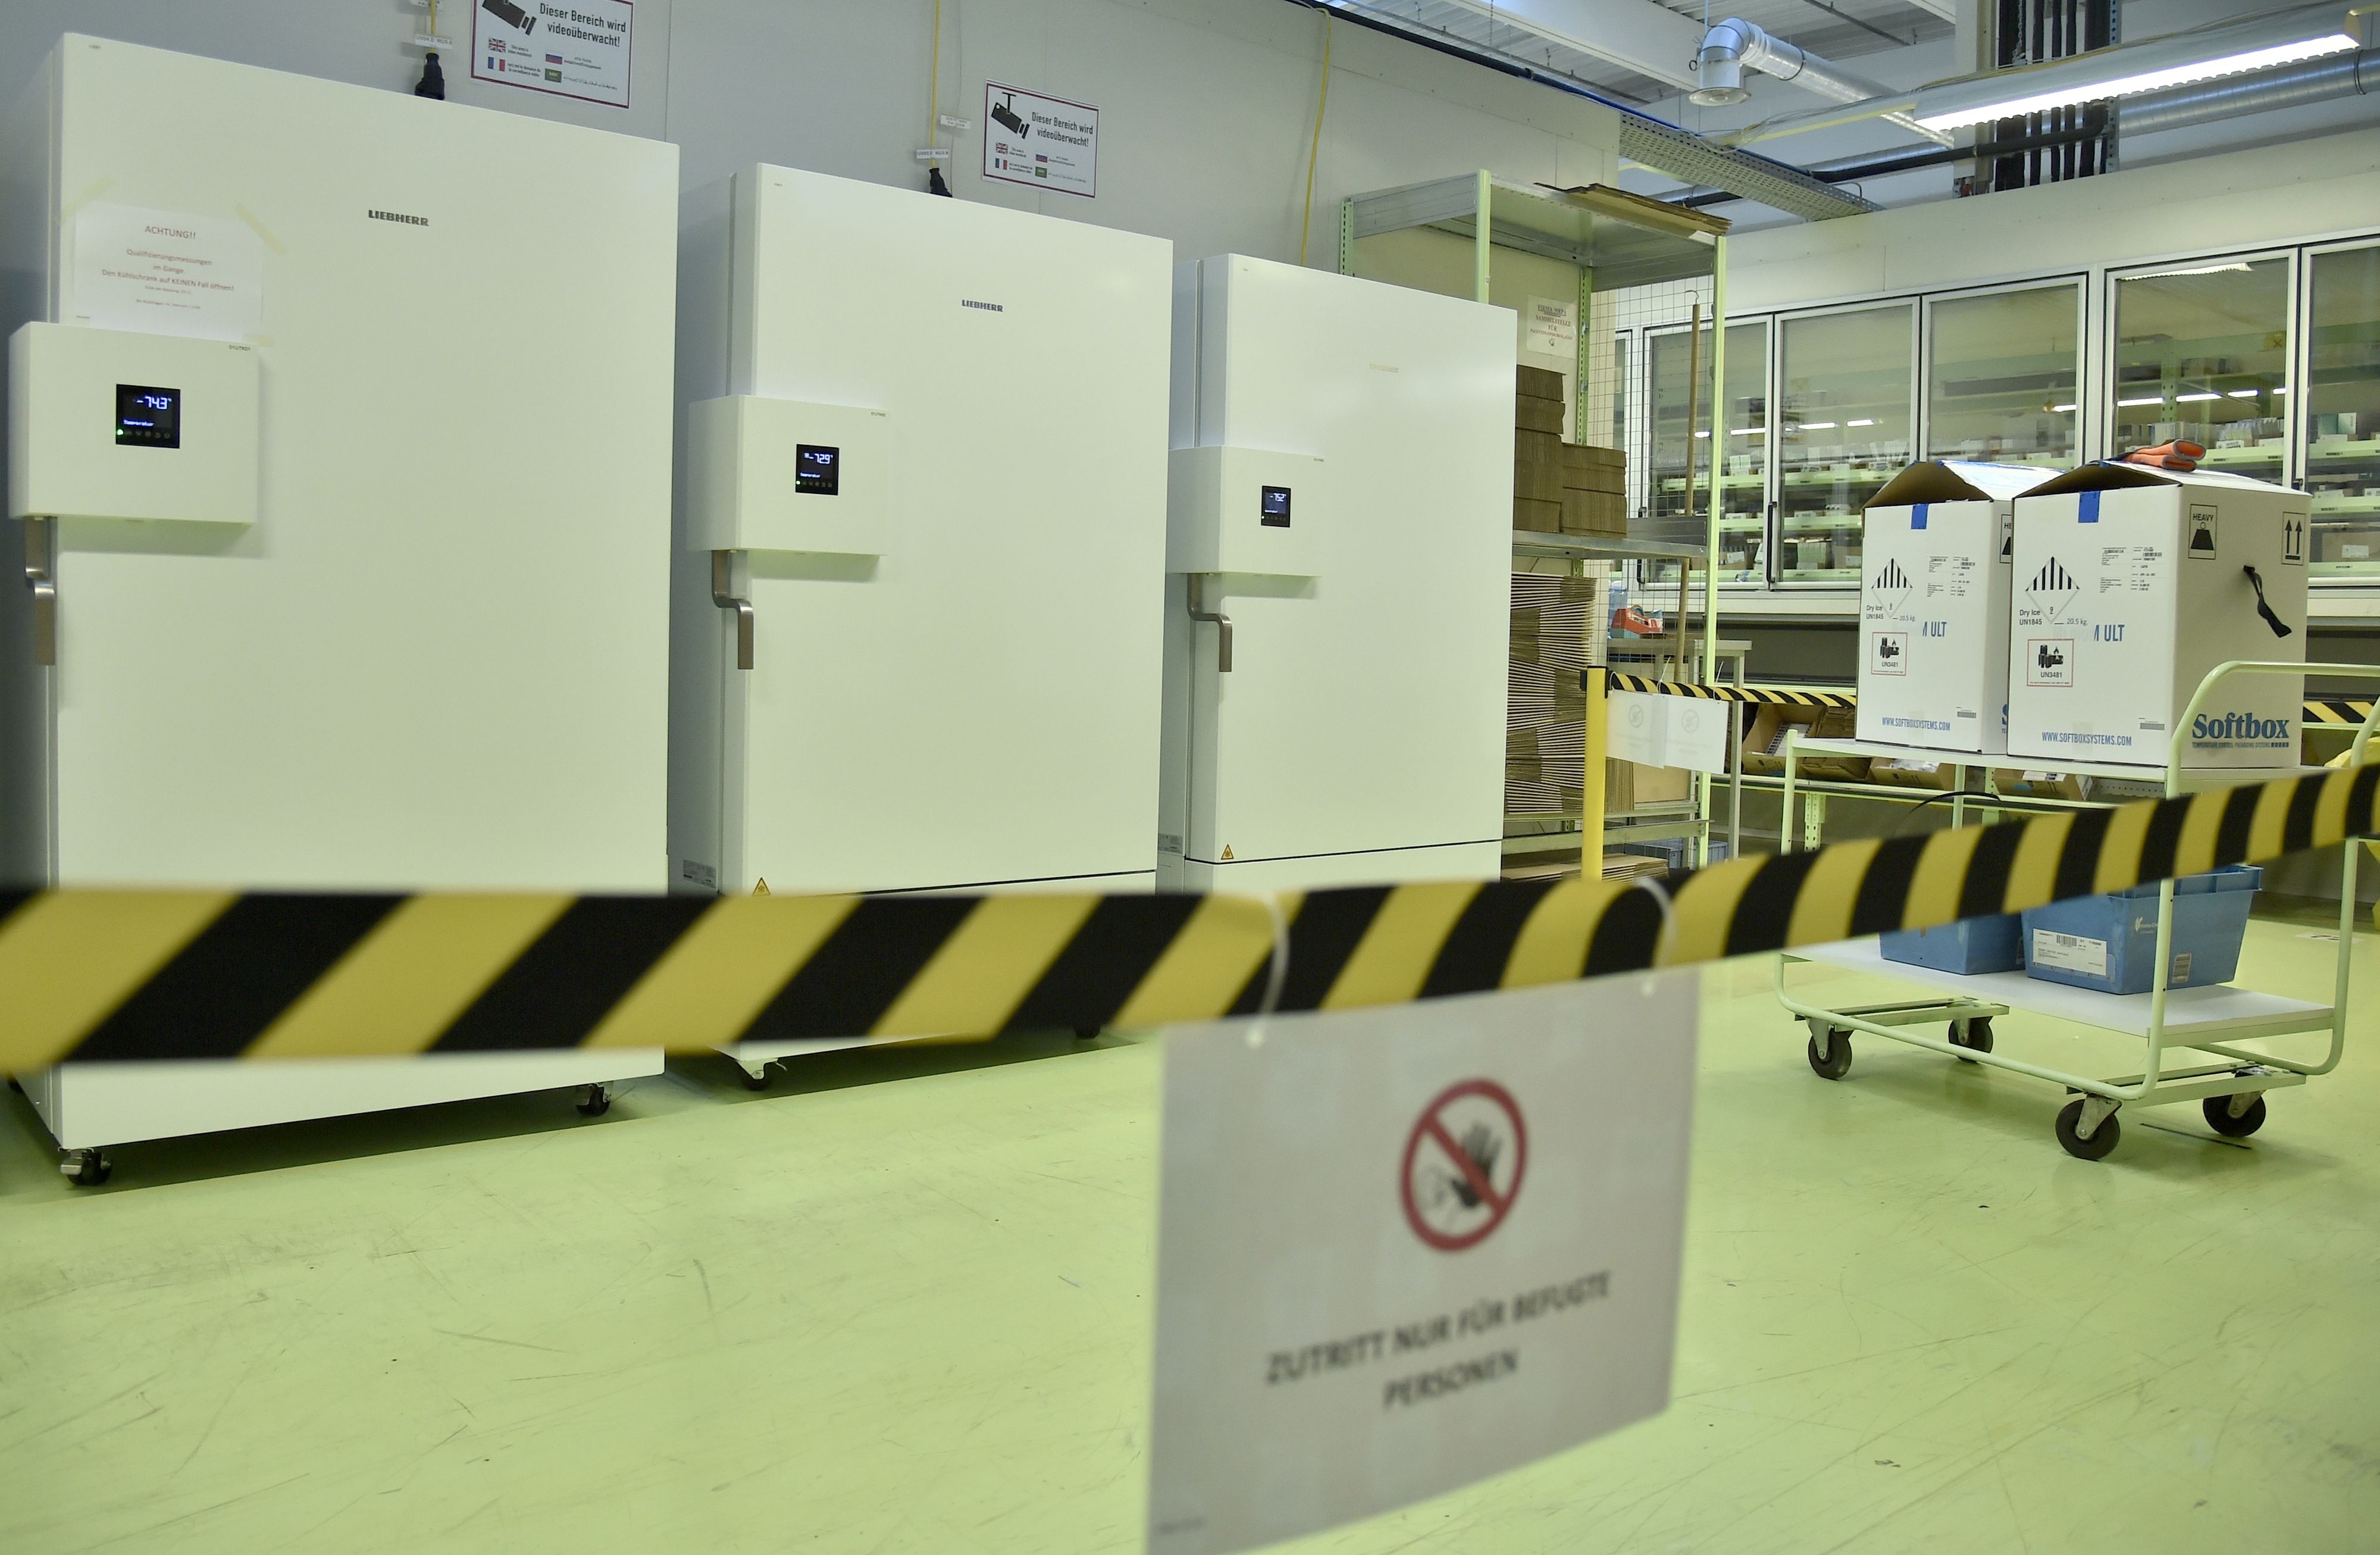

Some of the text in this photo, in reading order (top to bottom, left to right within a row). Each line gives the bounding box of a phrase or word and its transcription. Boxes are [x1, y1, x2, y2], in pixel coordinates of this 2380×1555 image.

[540, 3, 626, 33] Dieser Bereich wird
[547, 22, 620, 47] videoüberwacht!
[1032, 112, 1093, 134] Dieser Bereich wird
[1037, 128, 1089, 147] videoüberwacht!
[368, 209, 429, 227] LIEBHERR
[145, 226, 196, 239] ACHTUNG!!
[127, 249, 212, 266] Qualifizierungsmessungen
[962, 299, 1003, 312] LIEBHERR
[1535, 315, 1571, 327] SAMMELSTELLE
[1931, 622, 1947, 637] ULT
[2104, 625, 2125, 642] ULT
[1882, 717, 1950, 731] WWW.SOFTBOXSYSTEMS.COM
[2192, 712, 2289, 739] Softbox
[2042, 732, 2132, 746] WWW.SOFTBOXSYSTEMS.COM
[1266, 1269, 1611, 1386] ZUTRITT NUR FÜR BEFUGTE
[1383, 1348, 1519, 1411] PERSONEN
